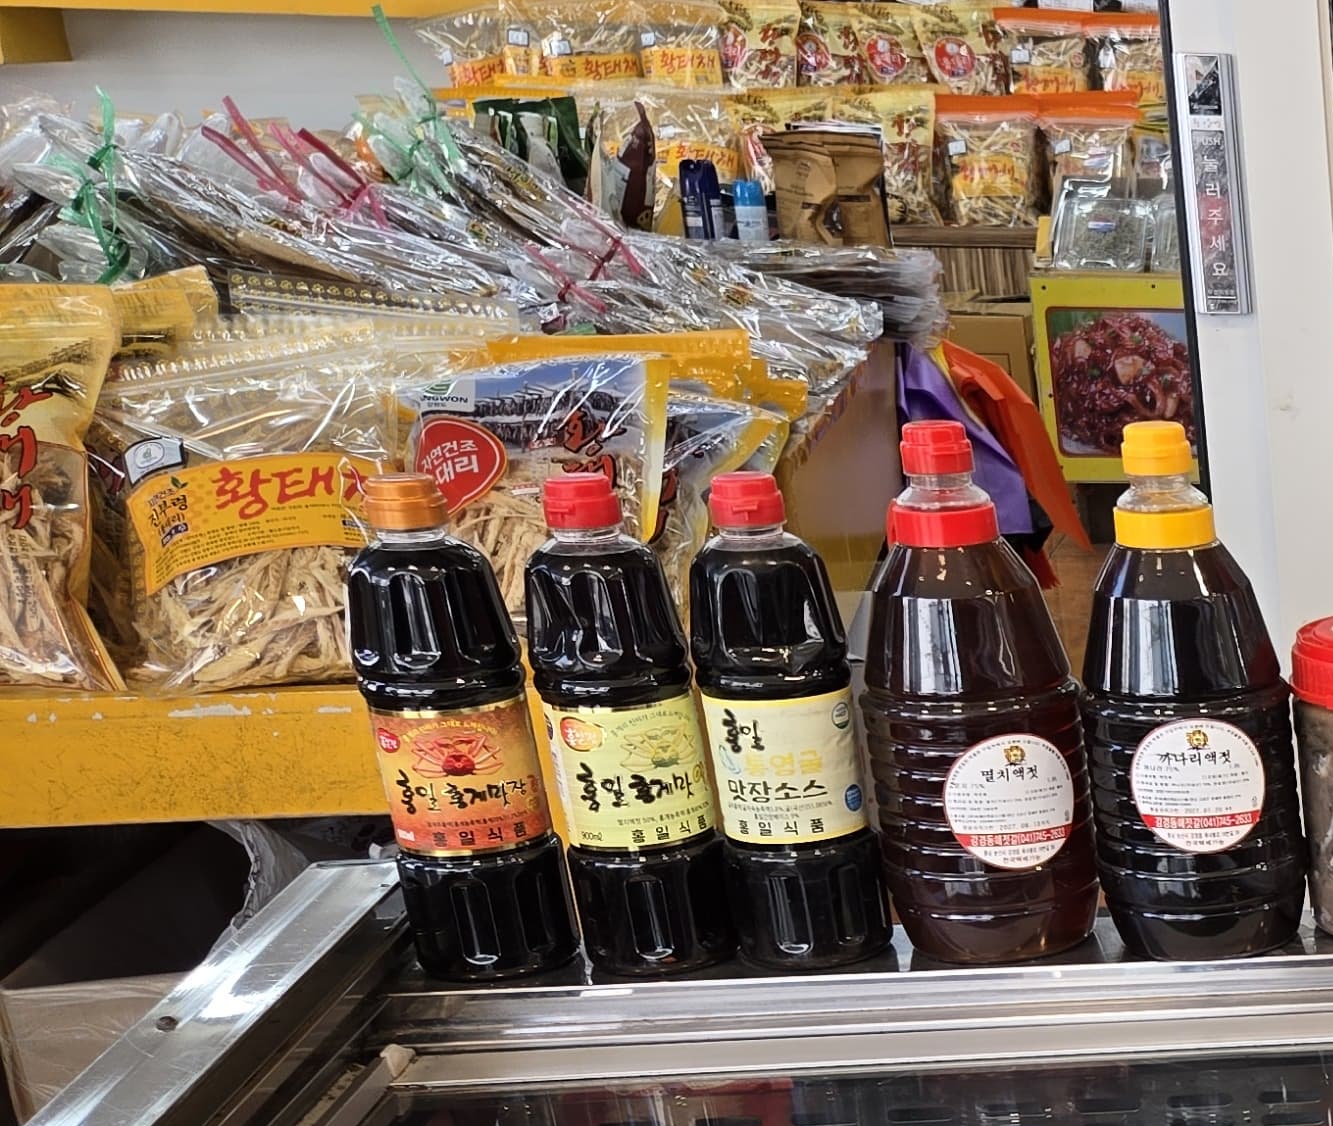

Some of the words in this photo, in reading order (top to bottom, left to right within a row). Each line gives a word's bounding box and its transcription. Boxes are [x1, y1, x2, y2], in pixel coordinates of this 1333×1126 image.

[661, 48, 715, 74] 황태채
[421, 439, 478, 471] 자연건조
[434, 454, 480, 484] 대리
[1155, 750, 1232, 767] 까나리액젓
[981, 765, 1039, 783] 멸치액젓
[728, 779, 828, 803] 맛장소스
